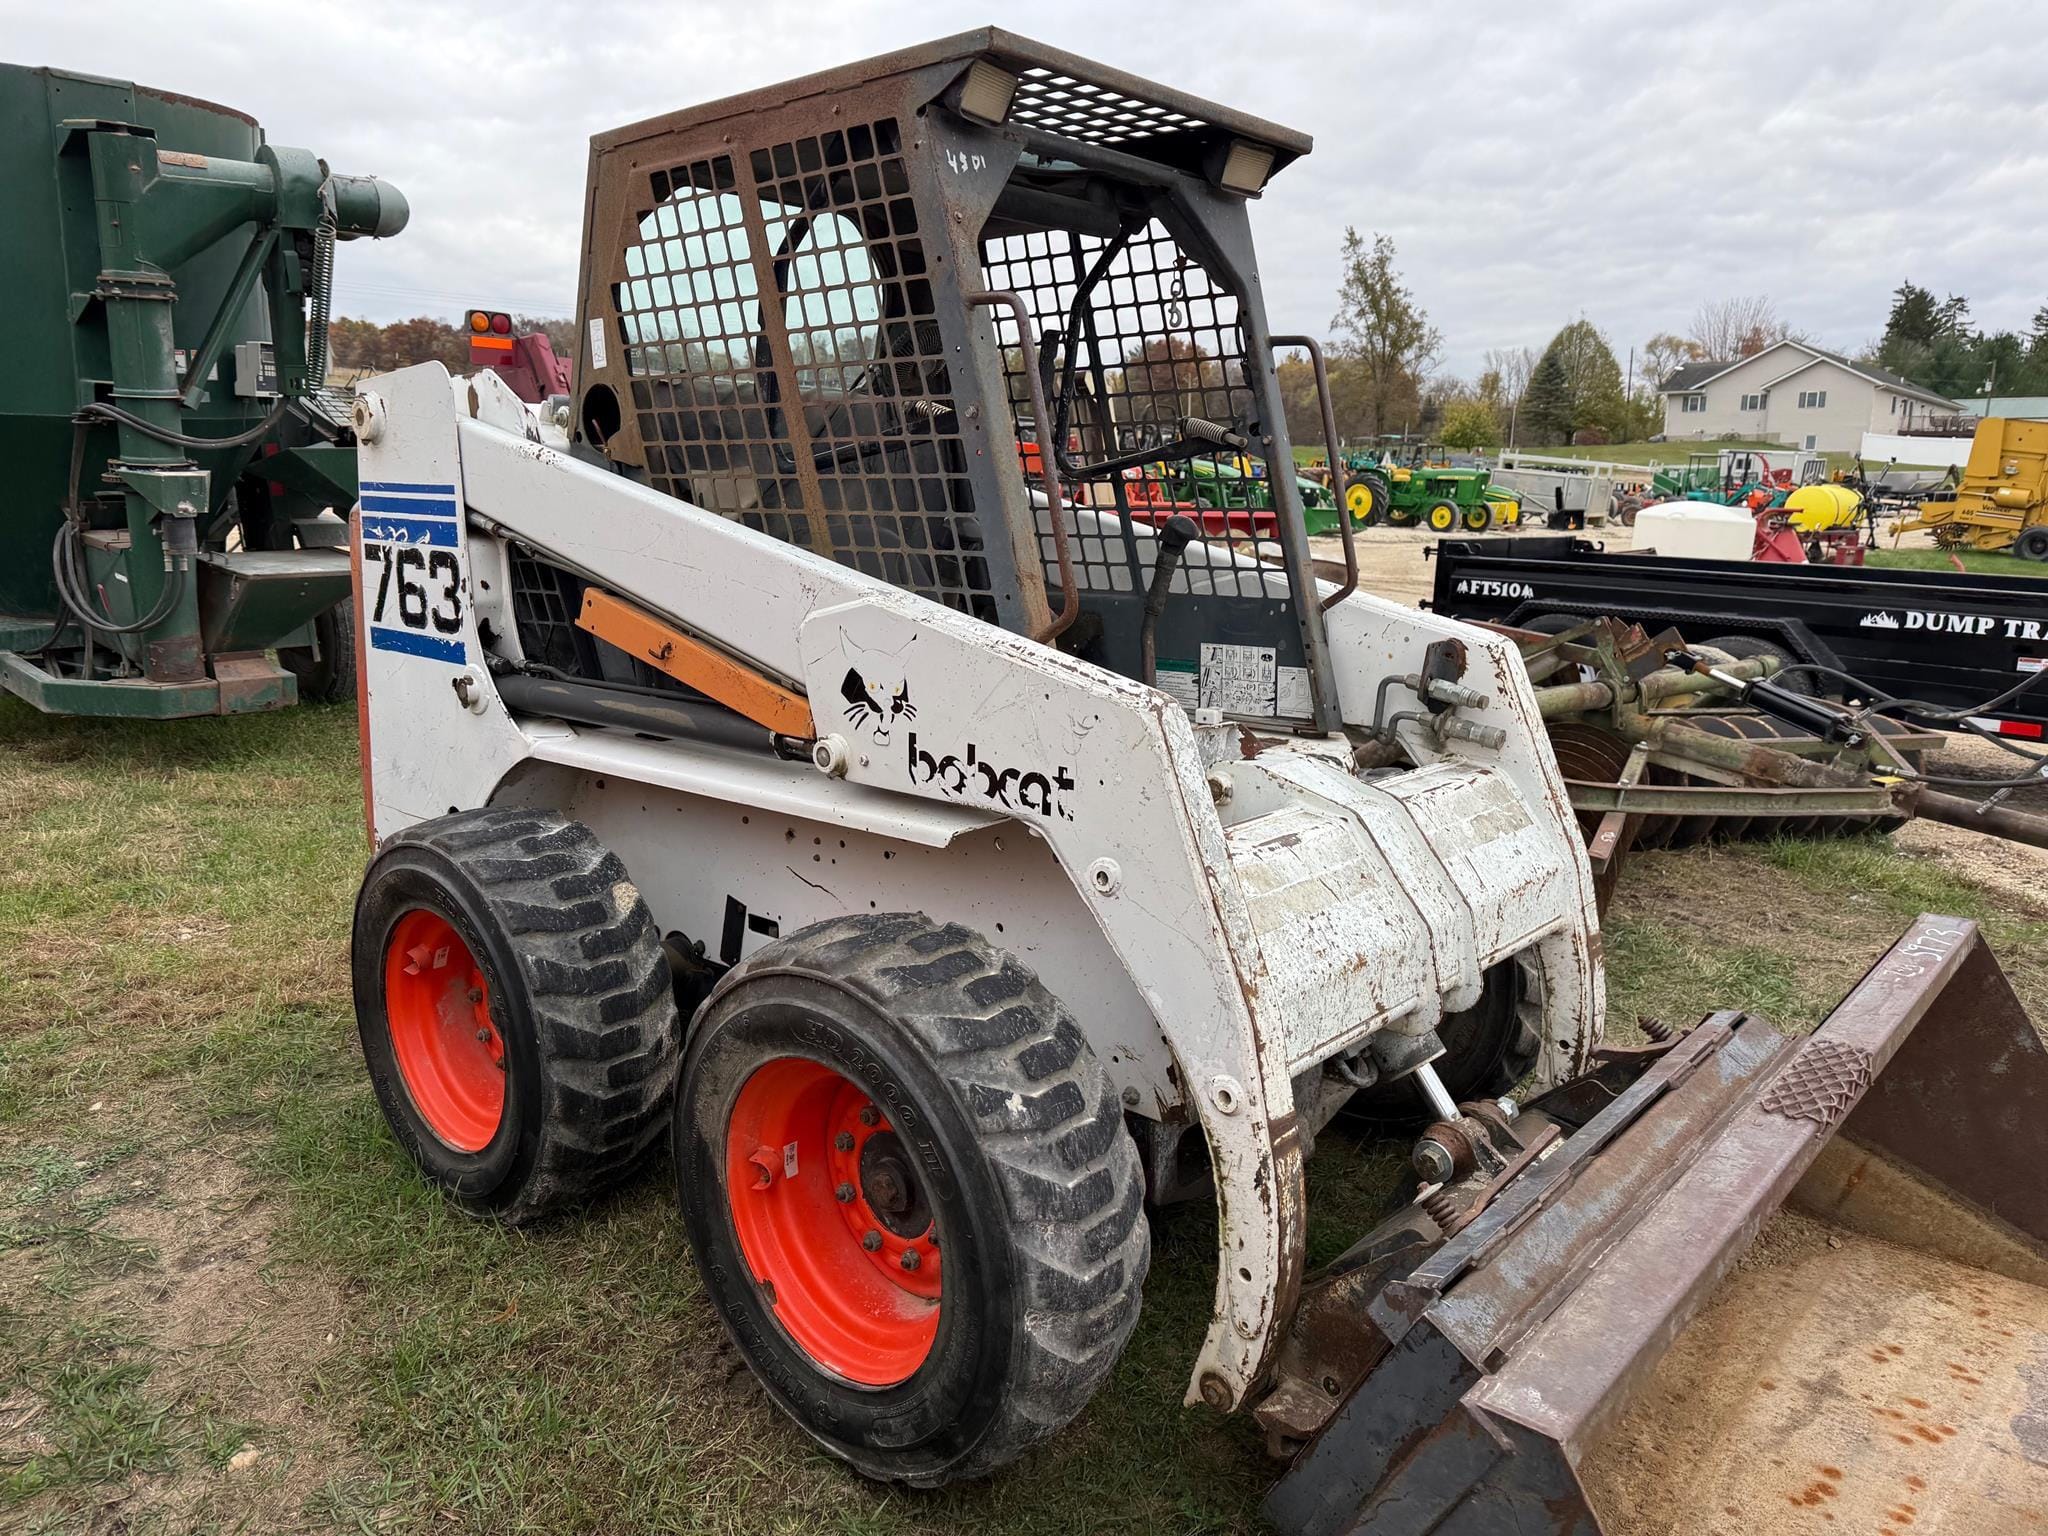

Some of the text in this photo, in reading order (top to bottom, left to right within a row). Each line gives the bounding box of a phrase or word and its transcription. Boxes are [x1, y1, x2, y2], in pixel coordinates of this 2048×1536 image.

[364, 543, 464, 635] 763
[1469, 580, 1521, 598] FT510
[1903, 611, 2048, 641] DUMP TR
[908, 731, 1076, 822] bobcat
